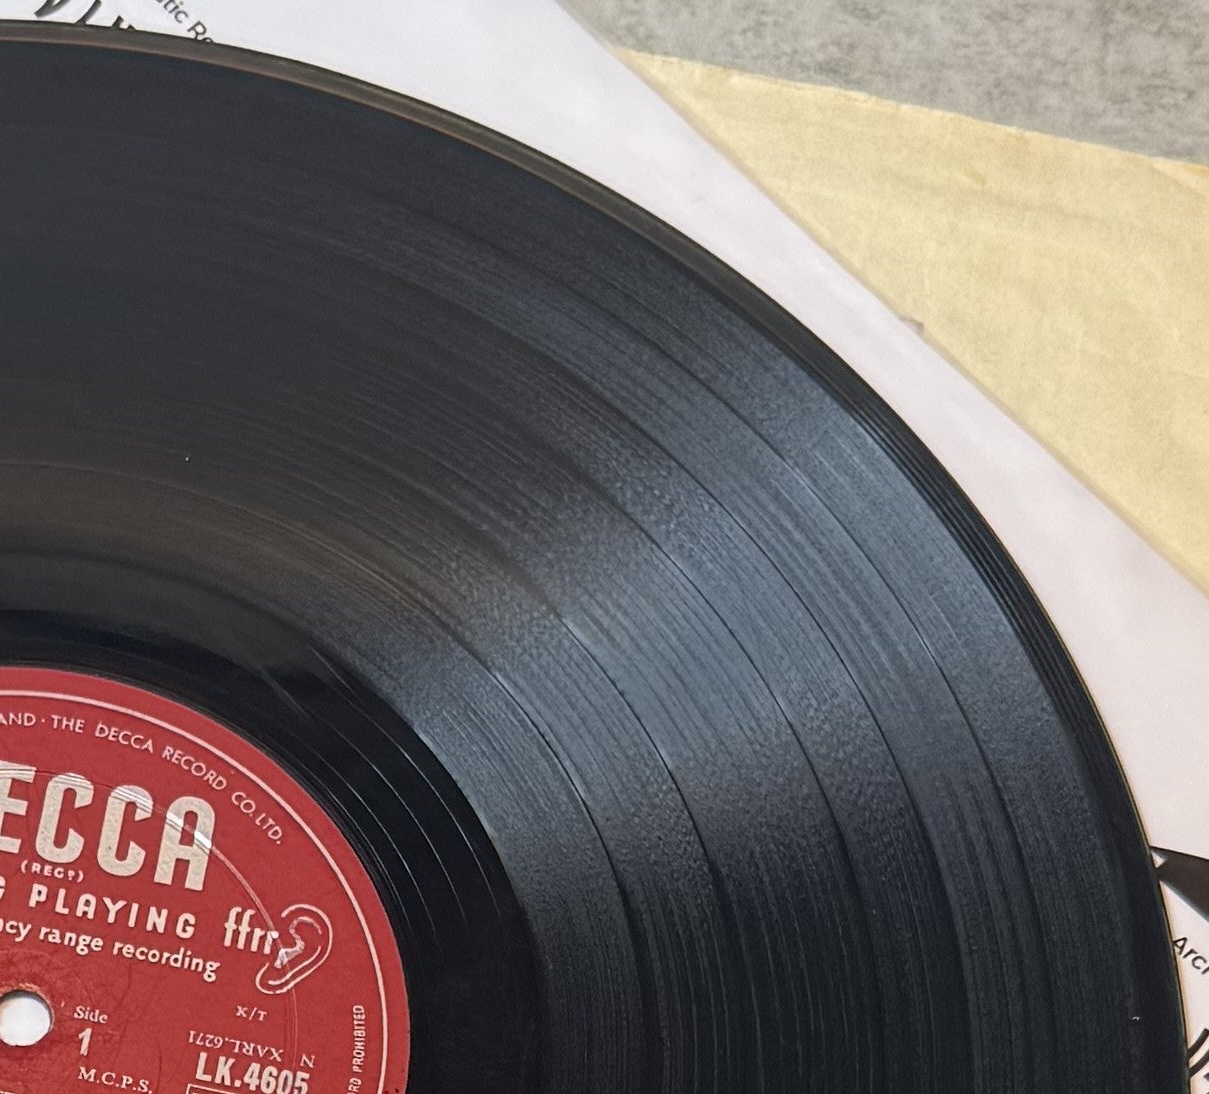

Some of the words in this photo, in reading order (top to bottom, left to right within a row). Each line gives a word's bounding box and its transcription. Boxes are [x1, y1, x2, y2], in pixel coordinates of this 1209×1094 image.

[51, 715, 84, 733] THE
[95, 722, 154, 753] DECCA
[162, 746, 226, 790] RECORD
[28, 883, 196, 939] PLAYING
[223, 906, 279, 955] ffrr
[40, 926, 104, 955] range
[112, 942, 220, 983] recording
[73, 1006, 109, 1024] Side
[352, 1004, 366, 1073] PROHIBITED
[77, 1028, 92, 1057] 1
[300, 1053, 316, 1068] N
[78, 1066, 153, 1094] M.C.P.S.
